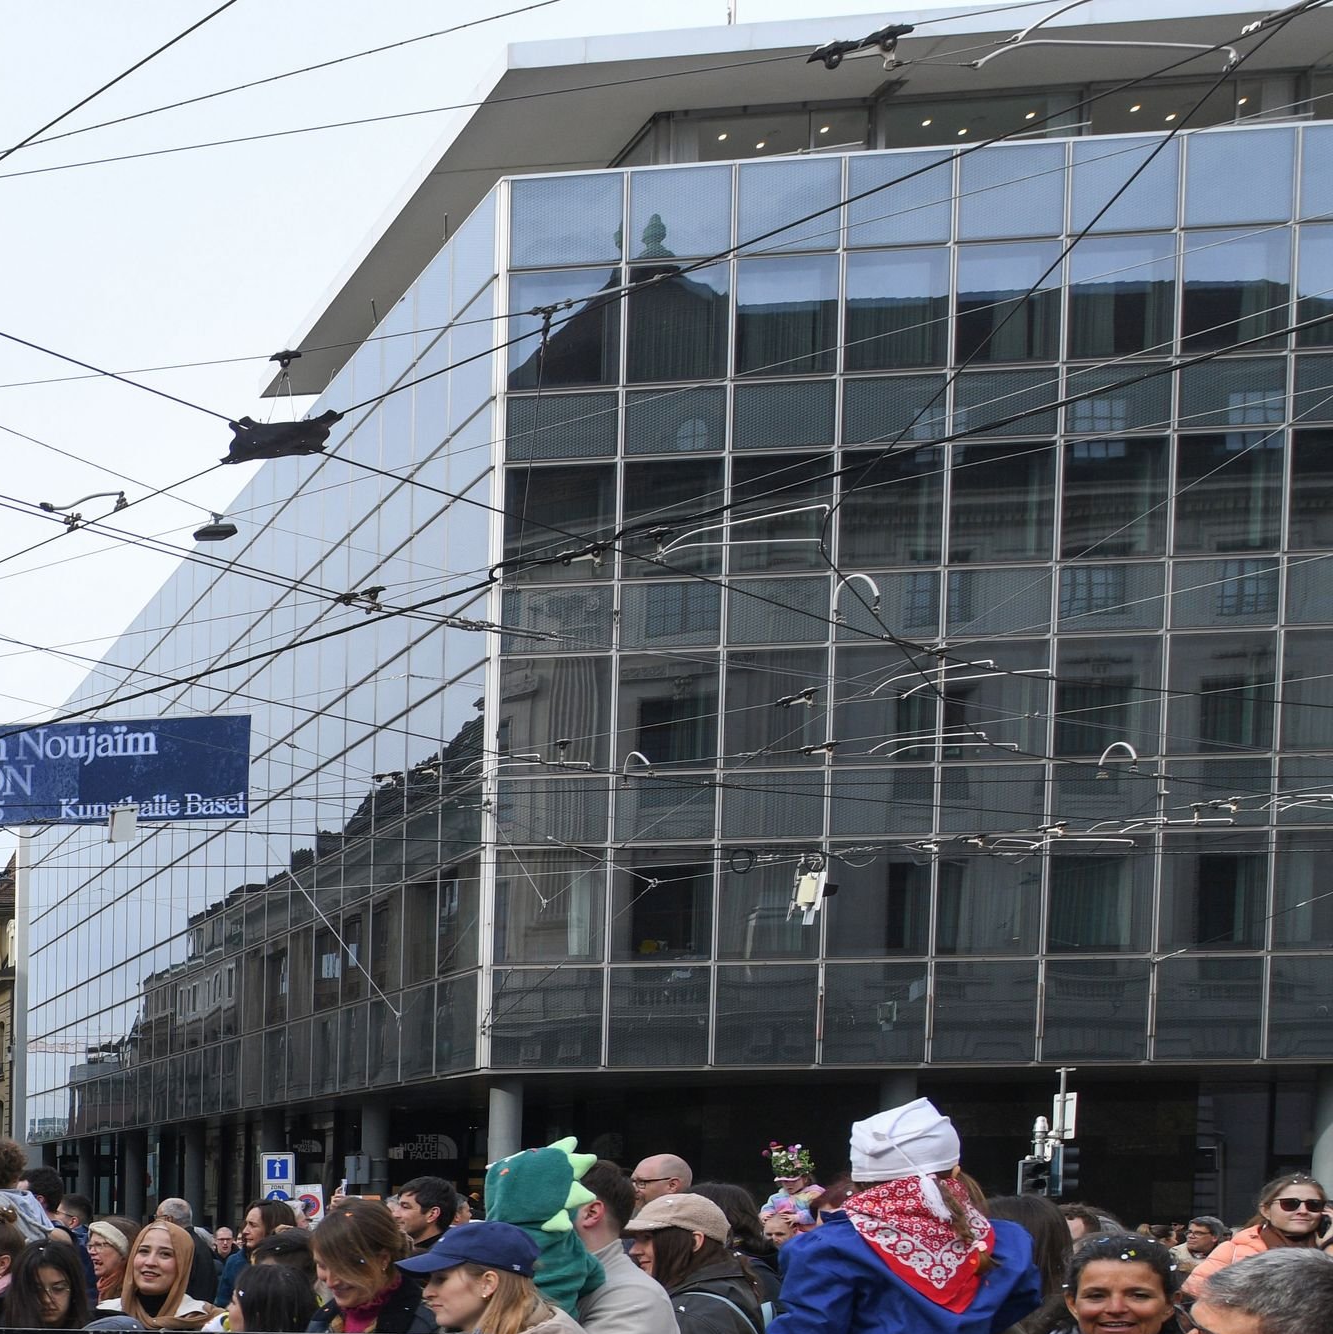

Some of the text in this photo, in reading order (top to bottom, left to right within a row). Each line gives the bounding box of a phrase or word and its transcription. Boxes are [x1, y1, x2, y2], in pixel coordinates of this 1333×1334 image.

[15, 725, 159, 766] Noujaïm
[184, 790, 245, 815] Basel
[416, 1134, 437, 1143] THE
[410, 1151, 437, 1160] FACE
